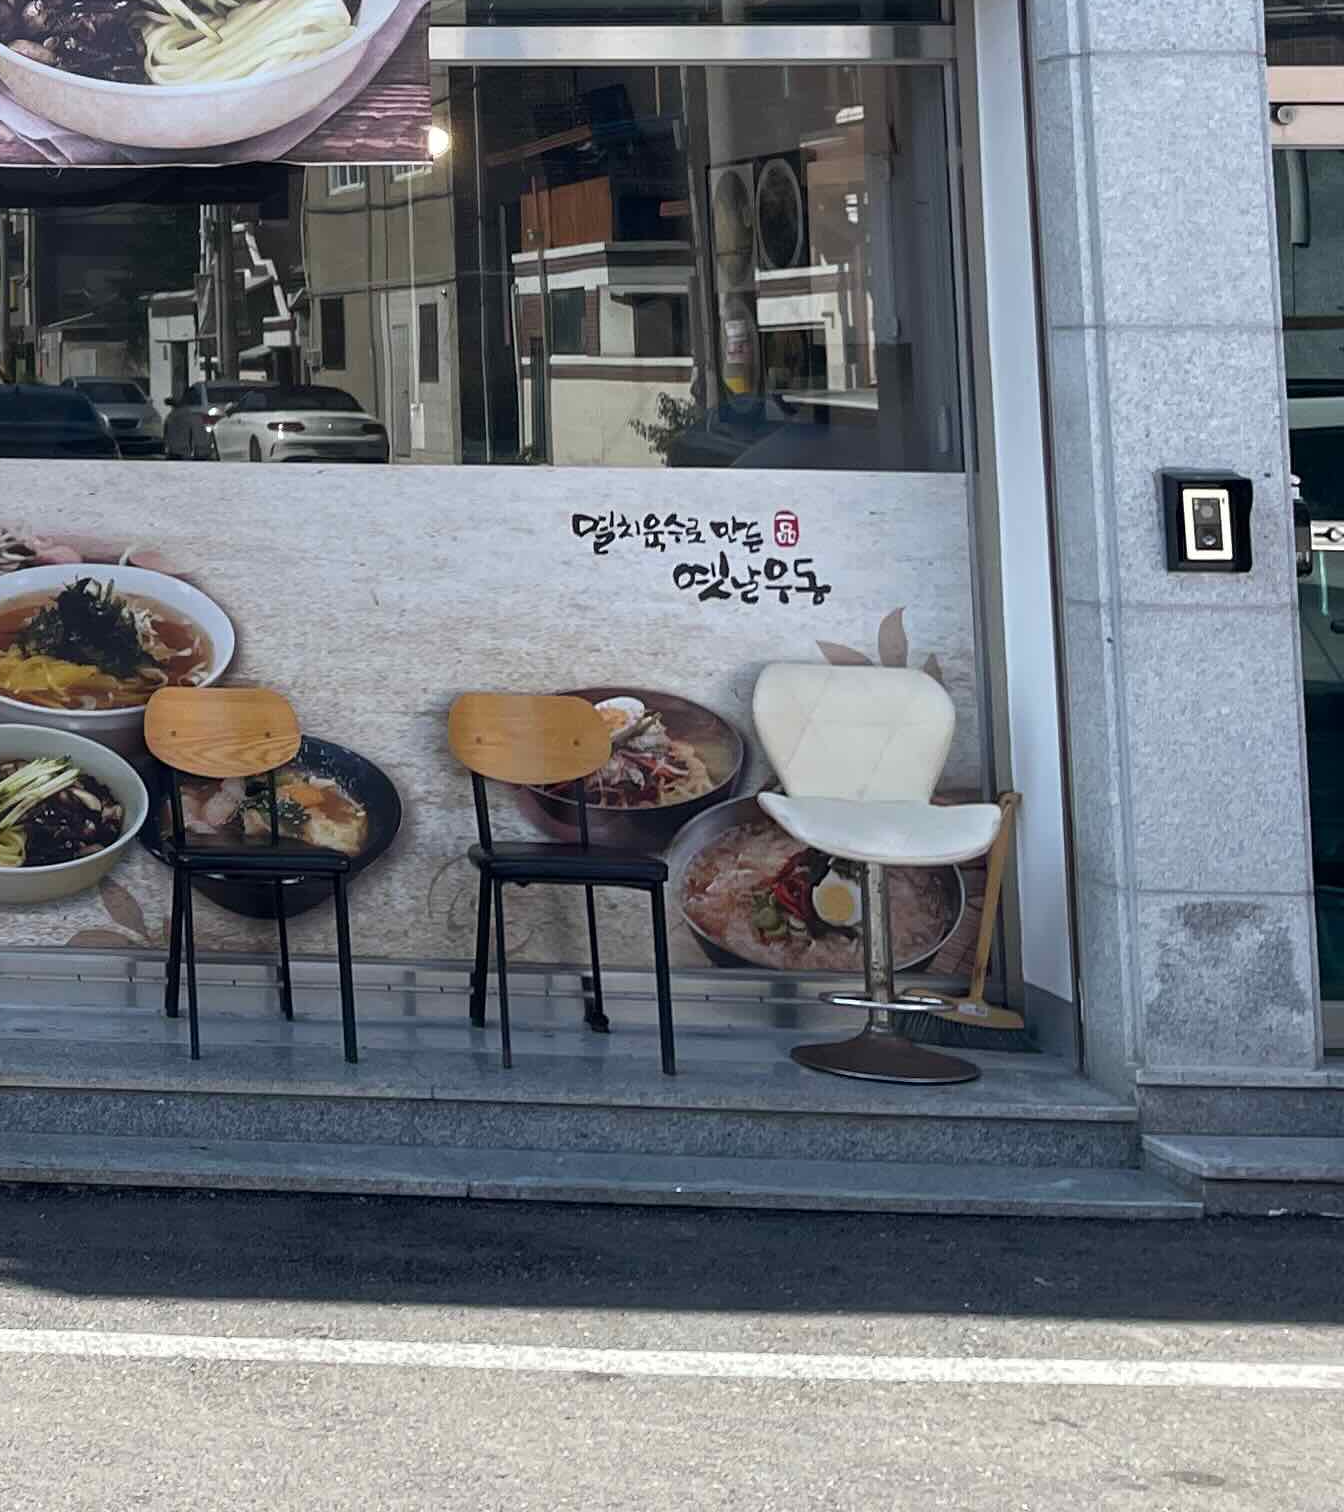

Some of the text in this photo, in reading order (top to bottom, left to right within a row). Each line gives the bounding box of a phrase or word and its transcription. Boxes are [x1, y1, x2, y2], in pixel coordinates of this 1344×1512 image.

[571, 511, 707, 555] 멸치육수로
[710, 514, 765, 553] 만든
[672, 552, 832, 605] 옛날우동
